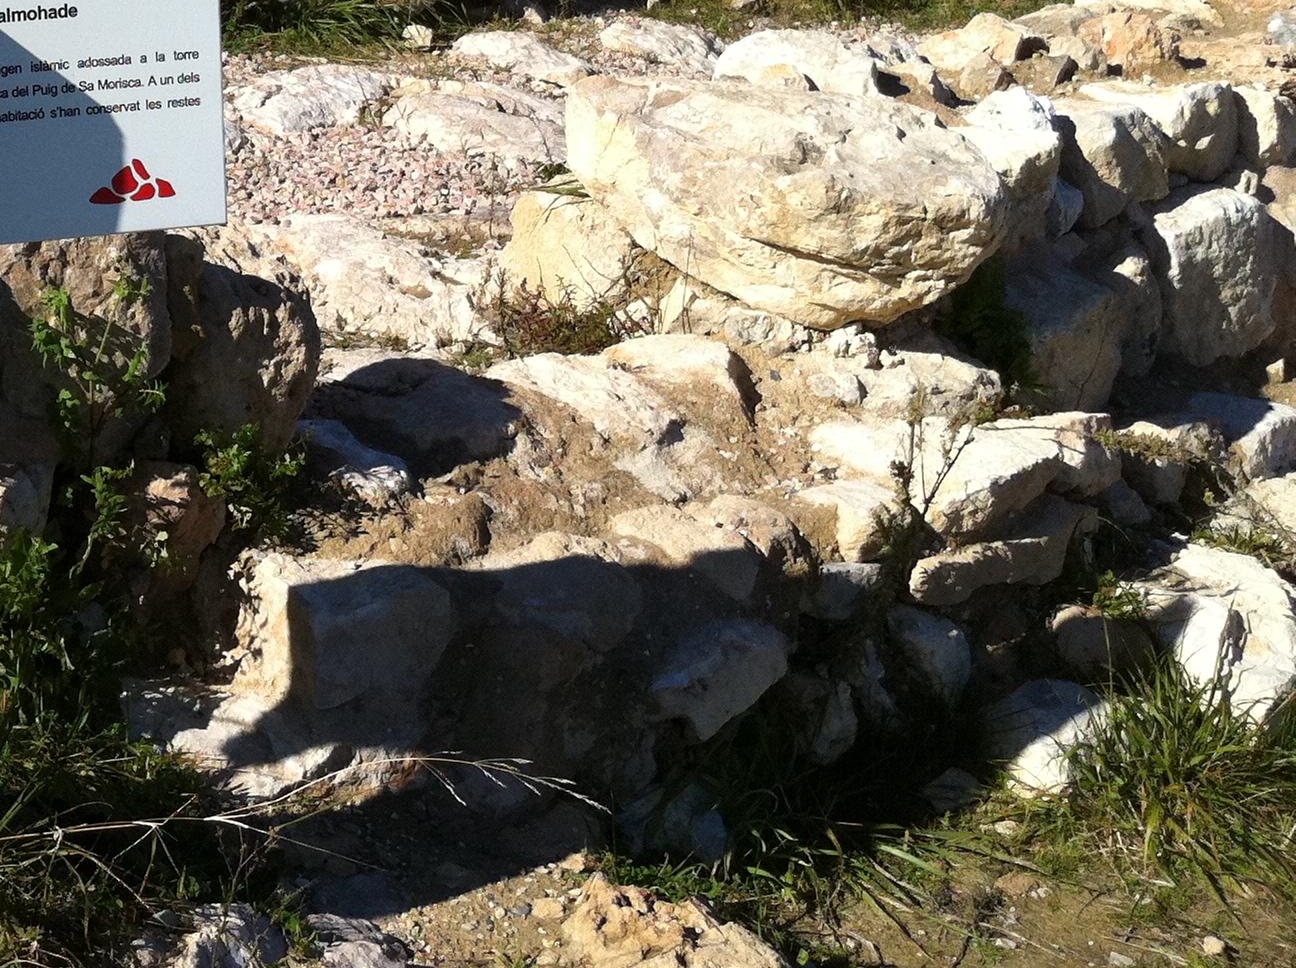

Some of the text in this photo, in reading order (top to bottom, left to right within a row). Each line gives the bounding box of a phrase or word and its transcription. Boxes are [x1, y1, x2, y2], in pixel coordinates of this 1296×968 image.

[30, 59, 70, 73] islàmic
[77, 54, 132, 69] adossada
[140, 55, 147, 64] a
[155, 51, 166, 63] la
[173, 50, 200, 61] torre
[12, 86, 29, 98] del
[32, 83, 58, 99] Puig
[62, 82, 76, 94] de
[79, 80, 95, 92] Sa
[148, 76, 157, 87] A
[160, 76, 174, 86] un
[177, 72, 200, 84] dels
[50, 106, 81, 120] s'han
[85, 101, 140, 116] conservat
[145, 99, 162, 110] les
[167, 96, 201, 109] restes
